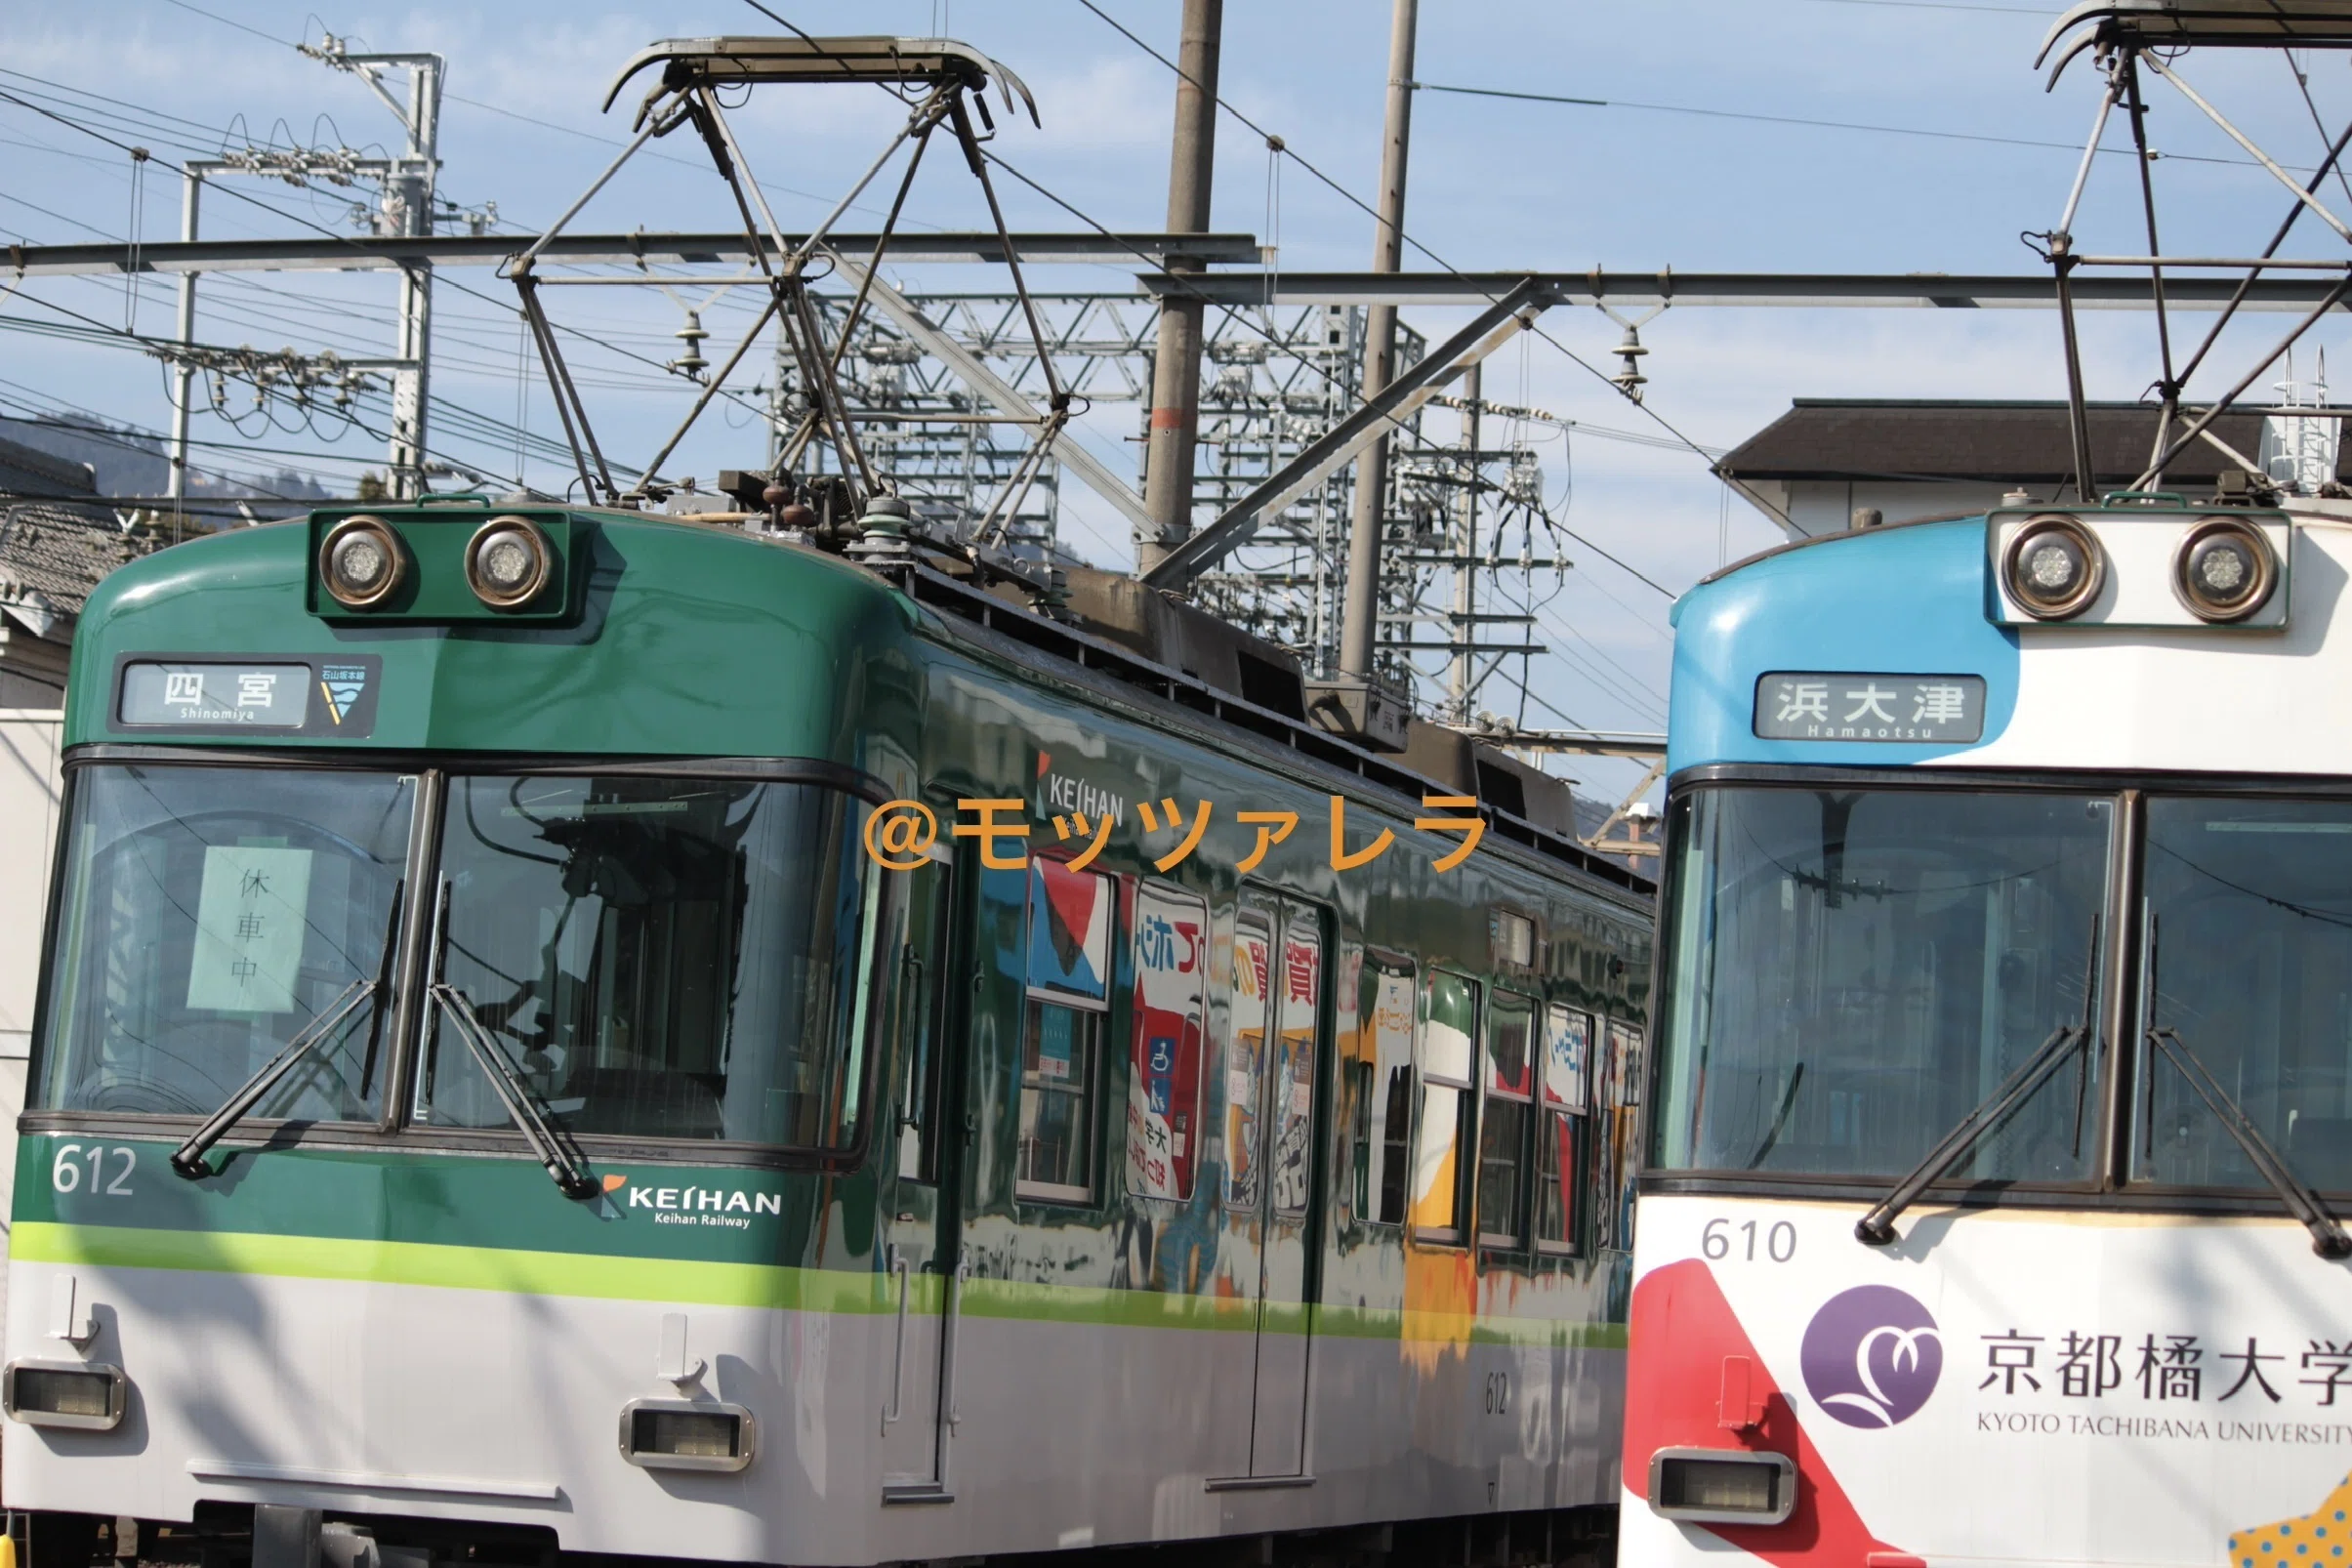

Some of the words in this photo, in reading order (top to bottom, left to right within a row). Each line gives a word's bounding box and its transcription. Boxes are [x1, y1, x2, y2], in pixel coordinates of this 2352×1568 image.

[164, 673, 276, 707] 四宮
[322, 670, 365, 681] 石山坂本線
[181, 708, 255, 722] Shinomiya
[1776, 682, 1964, 723] 浜大津
[1808, 724, 1931, 738] Hamaotsu
[1051, 773, 1123, 827] KEIHAN
[231, 869, 269, 987] 休車中
[53, 1143, 137, 1195] 612
[629, 1186, 781, 1215] KEIHAN
[655, 1213, 697, 1224] Keihan
[701, 1214, 750, 1229] Railway
[1702, 1217, 1796, 1262] 610
[1978, 1328, 2352, 1406] 京都橘大学
[1486, 1372, 1506, 1415] 612
[1977, 1412, 2061, 1434] KYOTO
[2069, 1415, 2209, 1440] TACHIBANA
